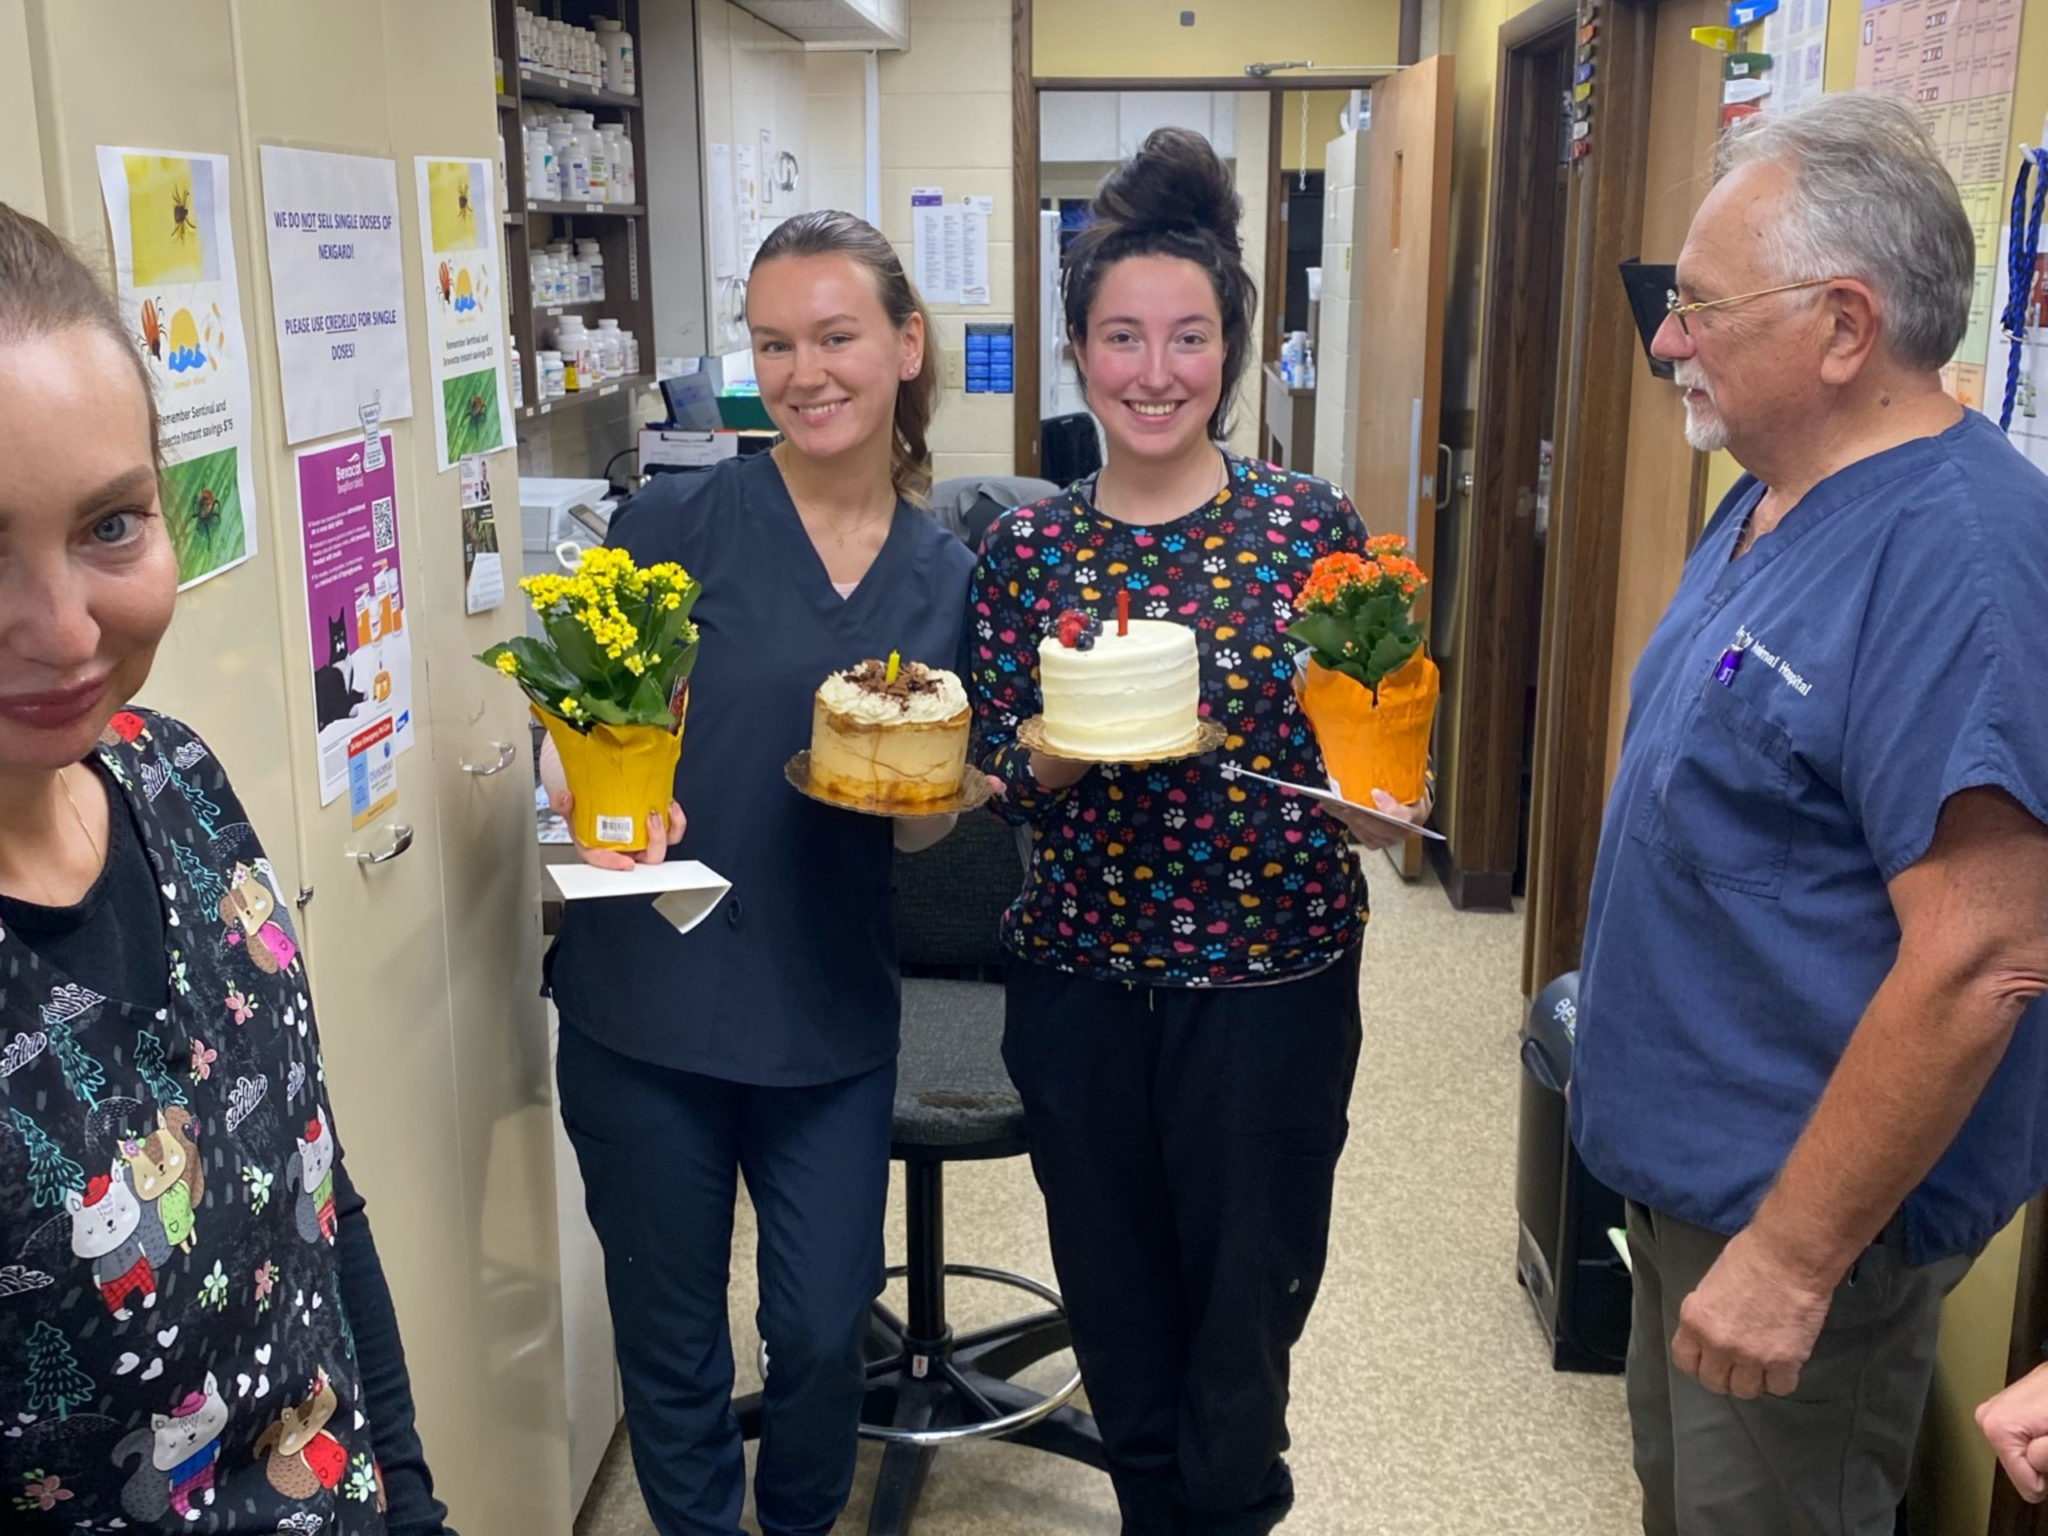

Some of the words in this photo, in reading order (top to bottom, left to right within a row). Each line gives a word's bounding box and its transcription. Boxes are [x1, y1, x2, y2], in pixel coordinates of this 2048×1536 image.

[274, 211, 287, 228] WE
[288, 212, 300, 228] DO
[301, 213, 317, 229] NOT
[317, 213, 334, 229] SELL
[334, 214, 359, 230] SINGLE
[359, 215, 381, 230] DOSES
[382, 215, 392, 230] OF
[318, 243, 355, 260] NEXGARD!
[285, 316, 311, 335] PLEASE
[311, 316, 325, 332] USE
[324, 312, 357, 331] CREDELIO
[358, 311, 372, 327] FOR
[372, 309, 397, 326] SINGLE
[331, 342, 357, 361] DOSES!
[215, 399, 226, 413] and
[202, 422, 223, 438] savings
[1778, 660, 1813, 696] Hospital
